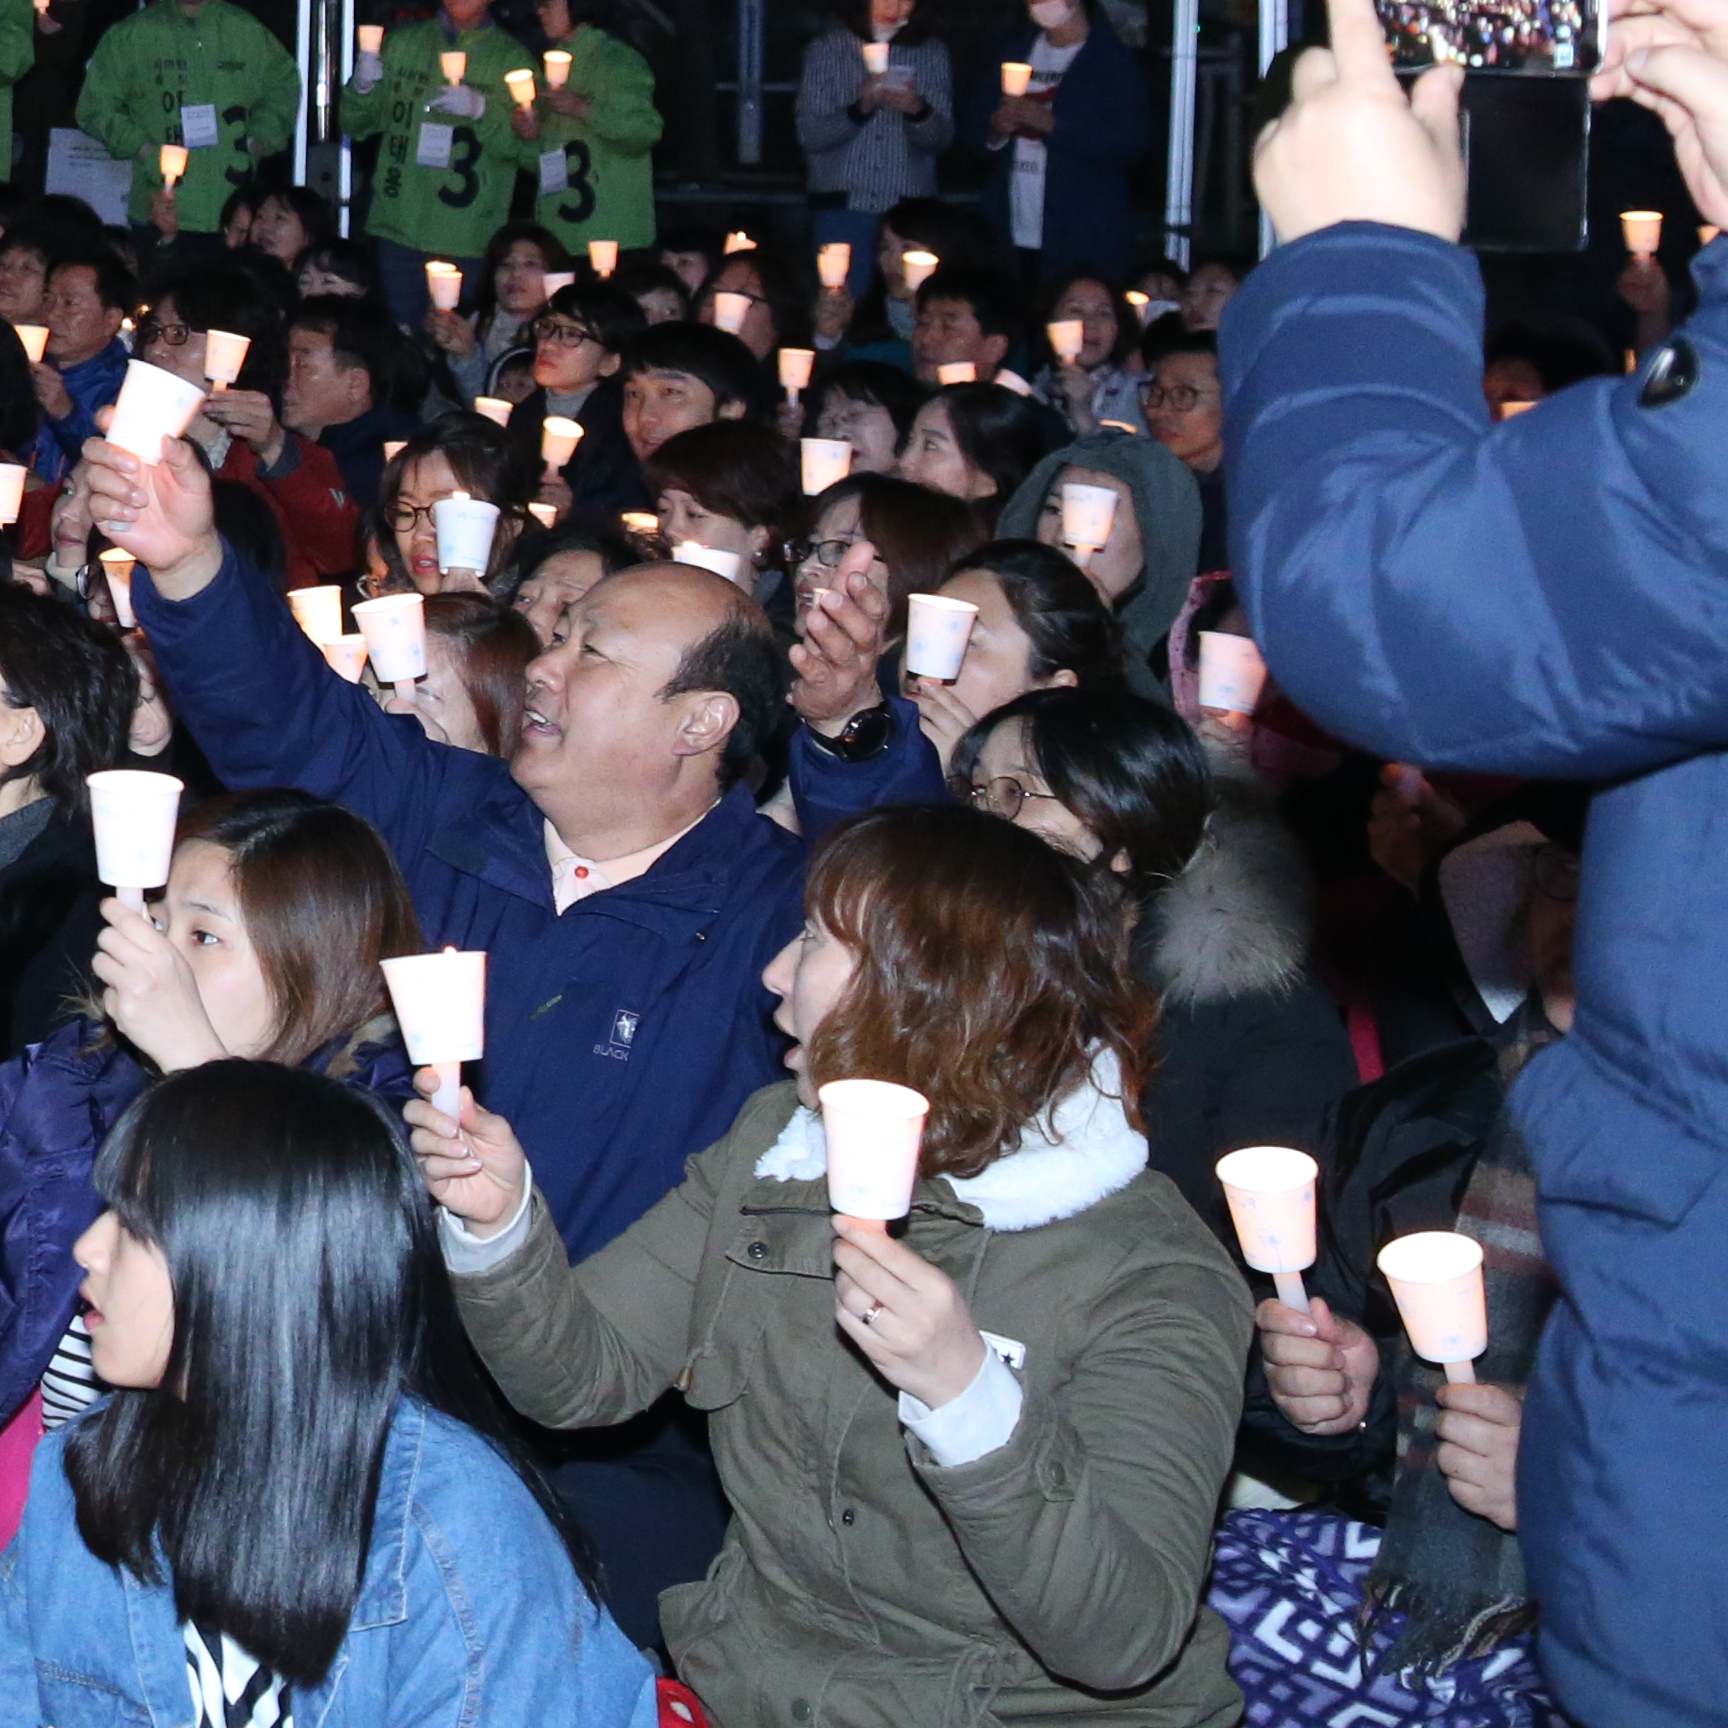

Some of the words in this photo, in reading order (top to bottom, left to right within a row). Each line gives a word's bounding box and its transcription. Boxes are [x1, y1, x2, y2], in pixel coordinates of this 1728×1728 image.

[437, 126, 484, 208] 3
[558, 138, 597, 222] 3
[592, 1044, 630, 1062] BLACK
